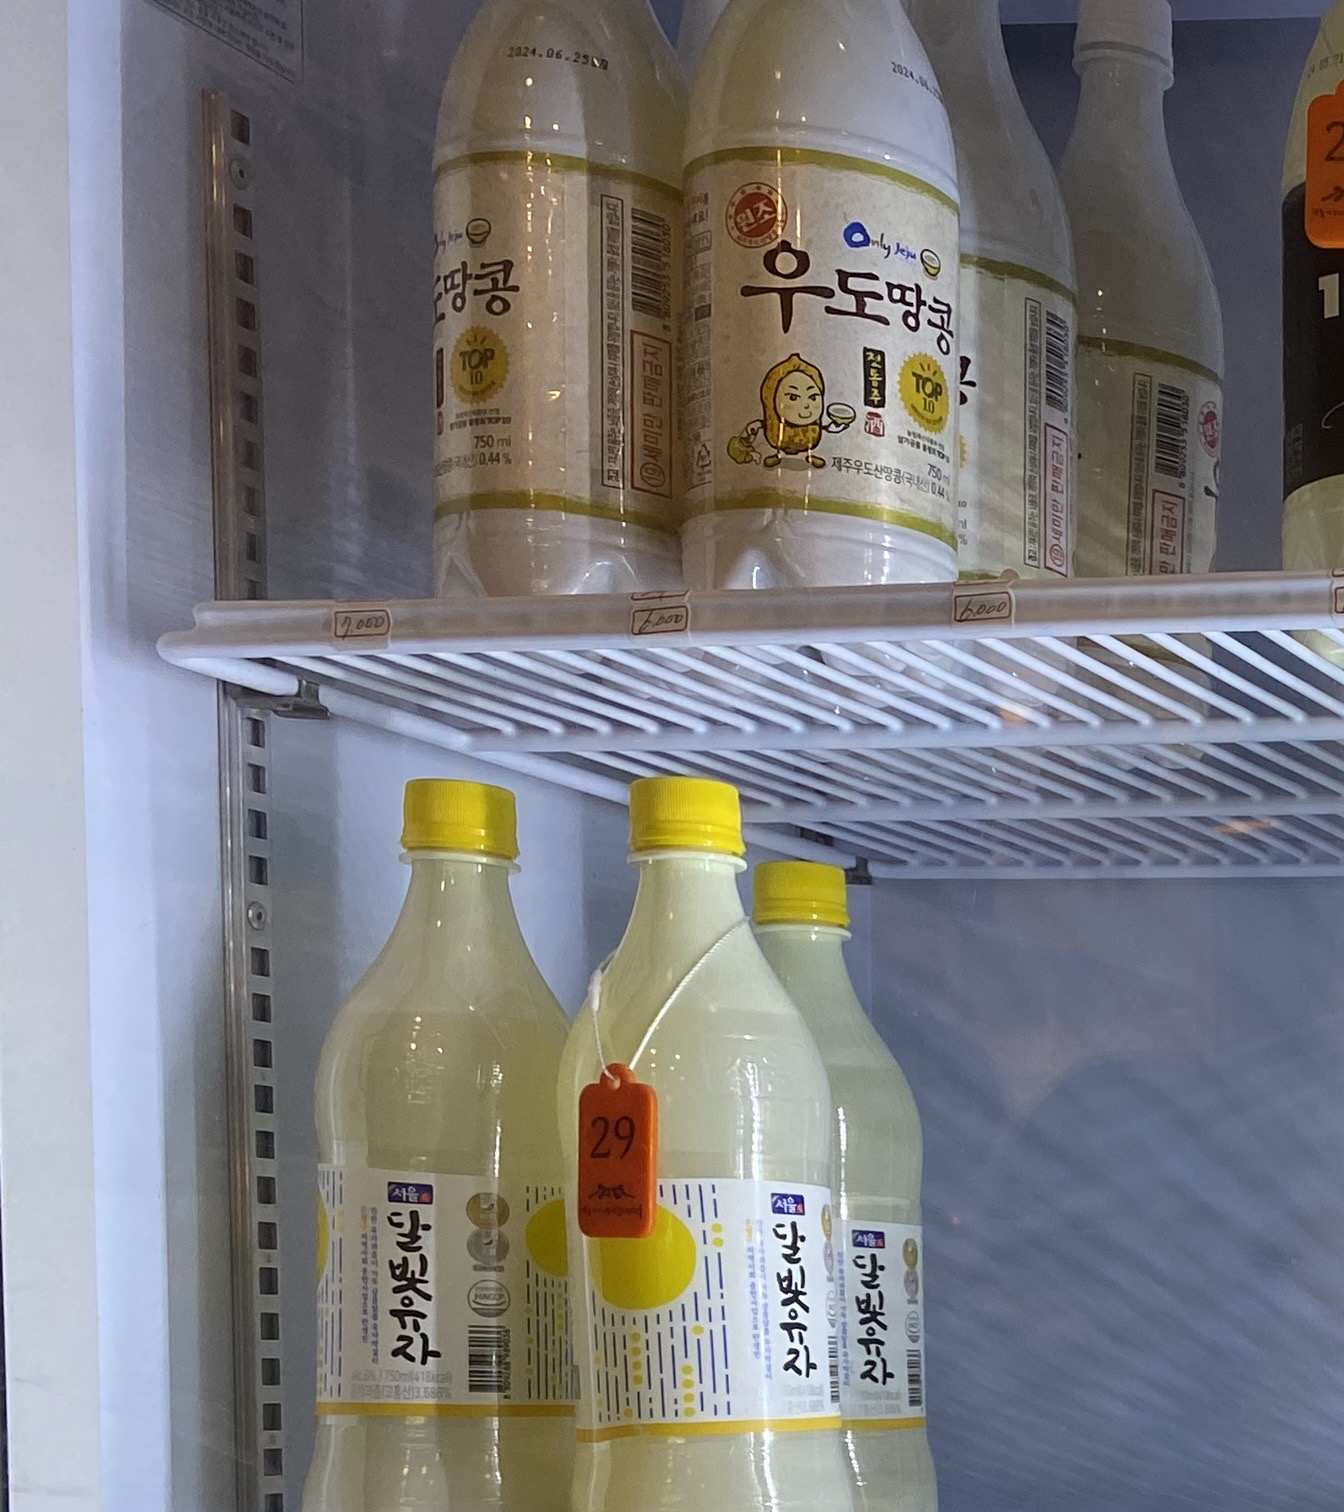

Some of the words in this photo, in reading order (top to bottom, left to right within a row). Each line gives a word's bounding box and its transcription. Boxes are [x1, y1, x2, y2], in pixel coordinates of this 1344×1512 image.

[843, 221, 891, 259] Only
[740, 239, 955, 357] 우도땅콩
[641, 342, 664, 410] 판매금지
[589, 1115, 635, 1159] 29
[386, 1209, 443, 1366] 달빛유자
[771, 1220, 818, 1379] 달빛유자
